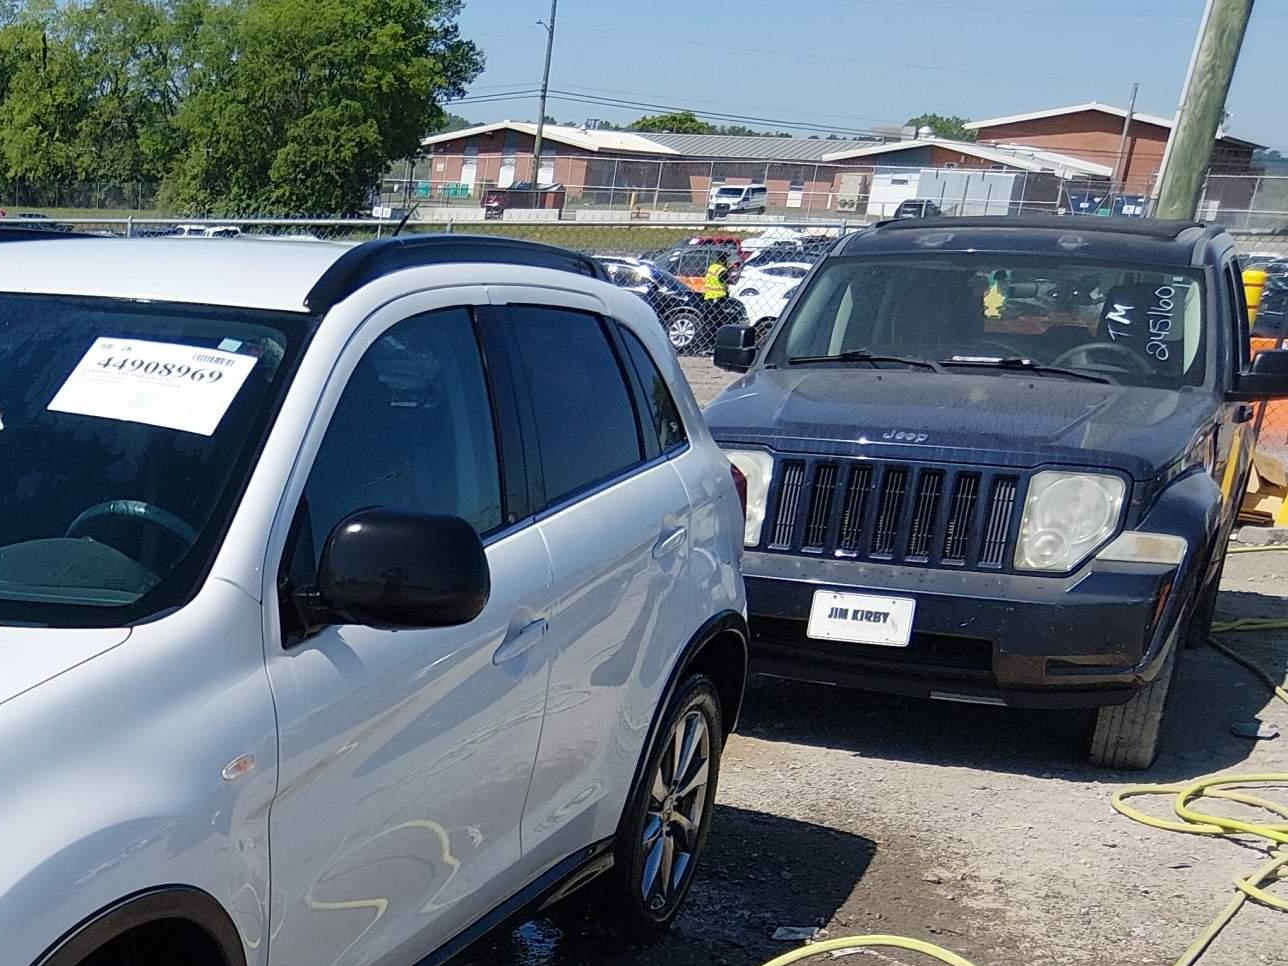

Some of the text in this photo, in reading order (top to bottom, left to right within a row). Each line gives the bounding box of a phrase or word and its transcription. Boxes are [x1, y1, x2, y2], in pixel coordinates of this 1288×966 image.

[1105, 304, 1135, 340] TM
[96, 355, 224, 384] 44908969
[883, 429, 929, 443] Jeep
[827, 606, 890, 624] JIM KIRBY
